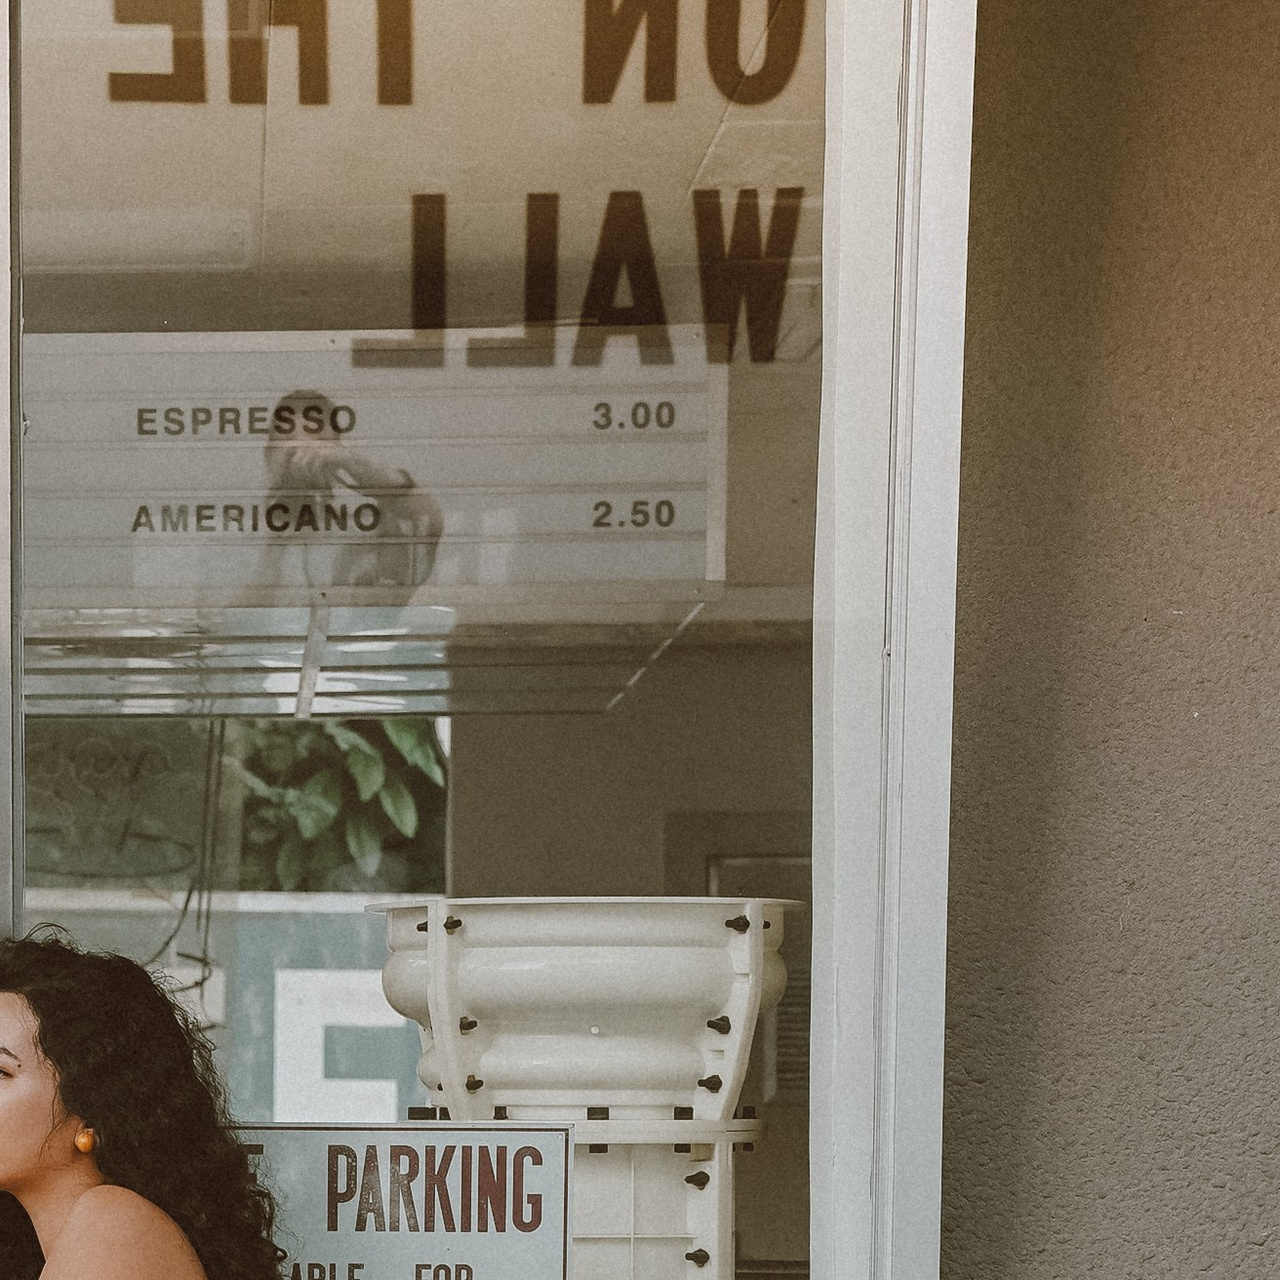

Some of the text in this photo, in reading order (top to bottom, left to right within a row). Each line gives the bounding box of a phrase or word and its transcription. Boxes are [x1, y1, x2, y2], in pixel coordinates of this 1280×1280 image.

[136, 402, 677, 436] ESPRESSO 3.00
[131, 500, 677, 533] AMERICANO 2.50
[326, 1144, 544, 1233] PARKING
